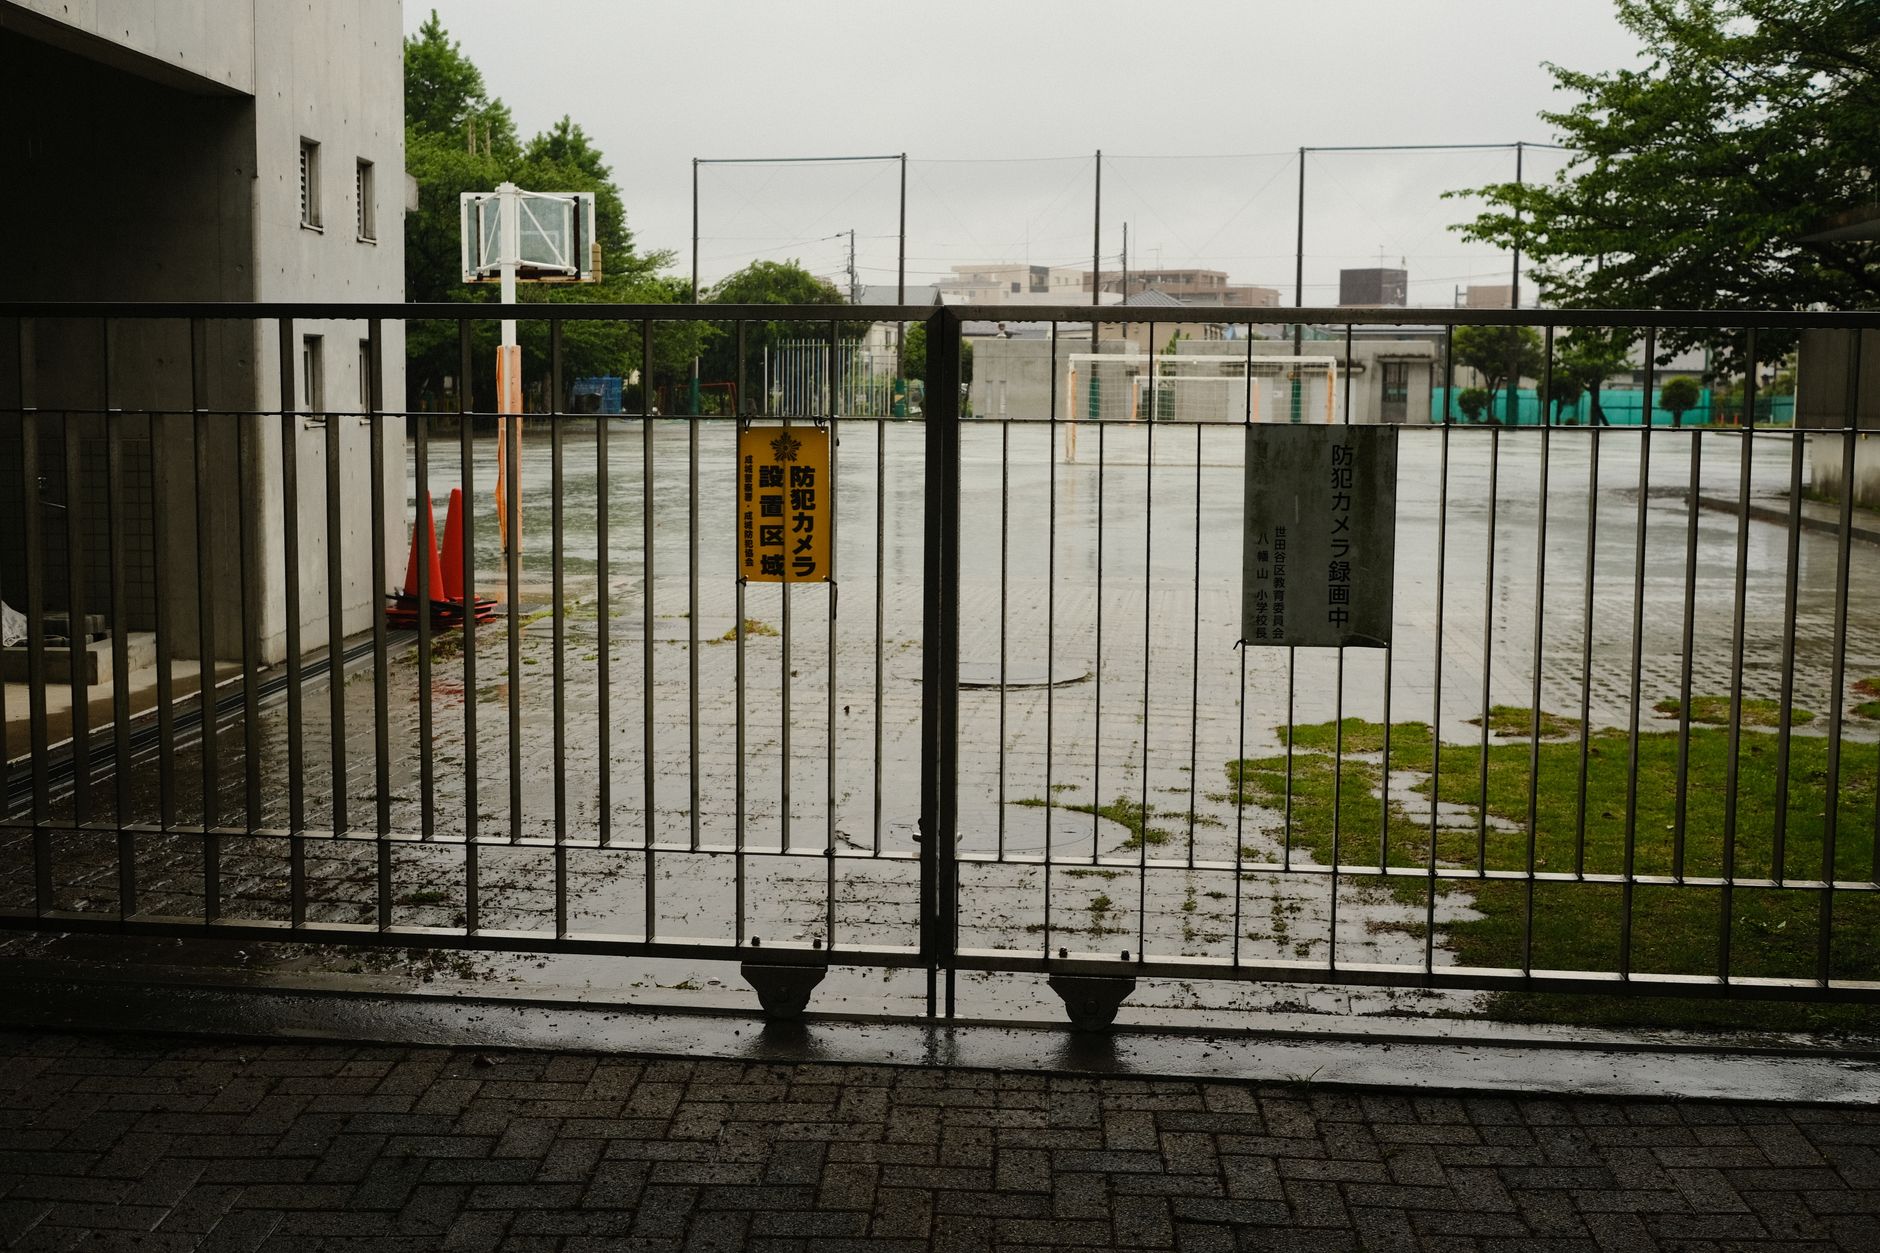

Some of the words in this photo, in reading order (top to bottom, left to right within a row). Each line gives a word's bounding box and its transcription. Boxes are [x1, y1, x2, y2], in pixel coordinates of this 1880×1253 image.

[759, 465, 785, 576] 設置区域
[790, 465, 816, 577] 防犯カメラ
[1328, 444, 1354, 629] 防犯カメラ録画中
[1272, 525, 1287, 639] 世田谷区教育委員会
